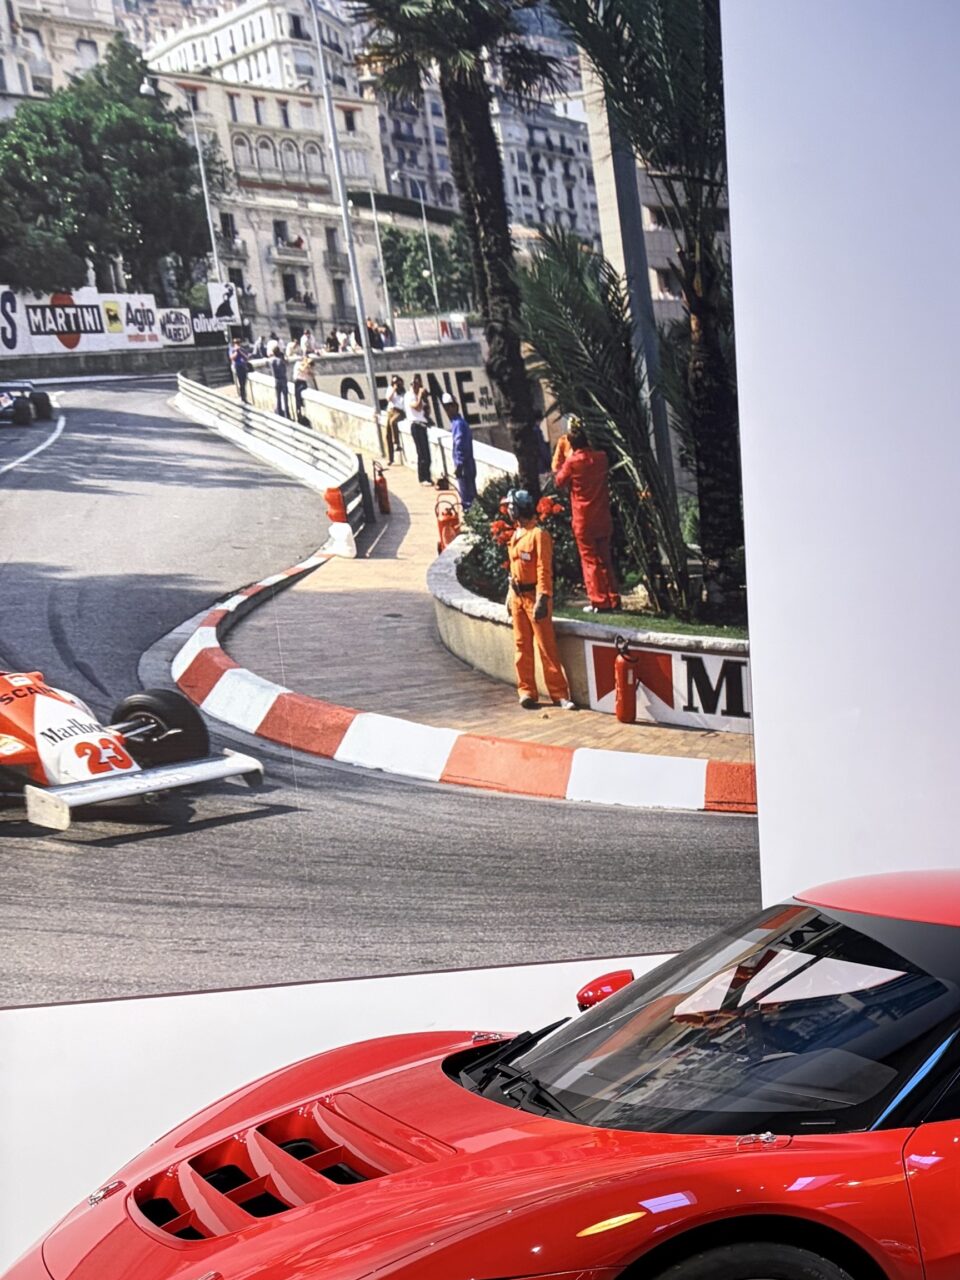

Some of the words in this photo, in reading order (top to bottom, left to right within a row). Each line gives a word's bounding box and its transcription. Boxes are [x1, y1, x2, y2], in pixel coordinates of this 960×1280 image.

[29, 307, 103, 332] MARTINI
[125, 302, 155, 332] Agip
[681, 654, 751, 719] M
[74, 738, 133, 775] 23
